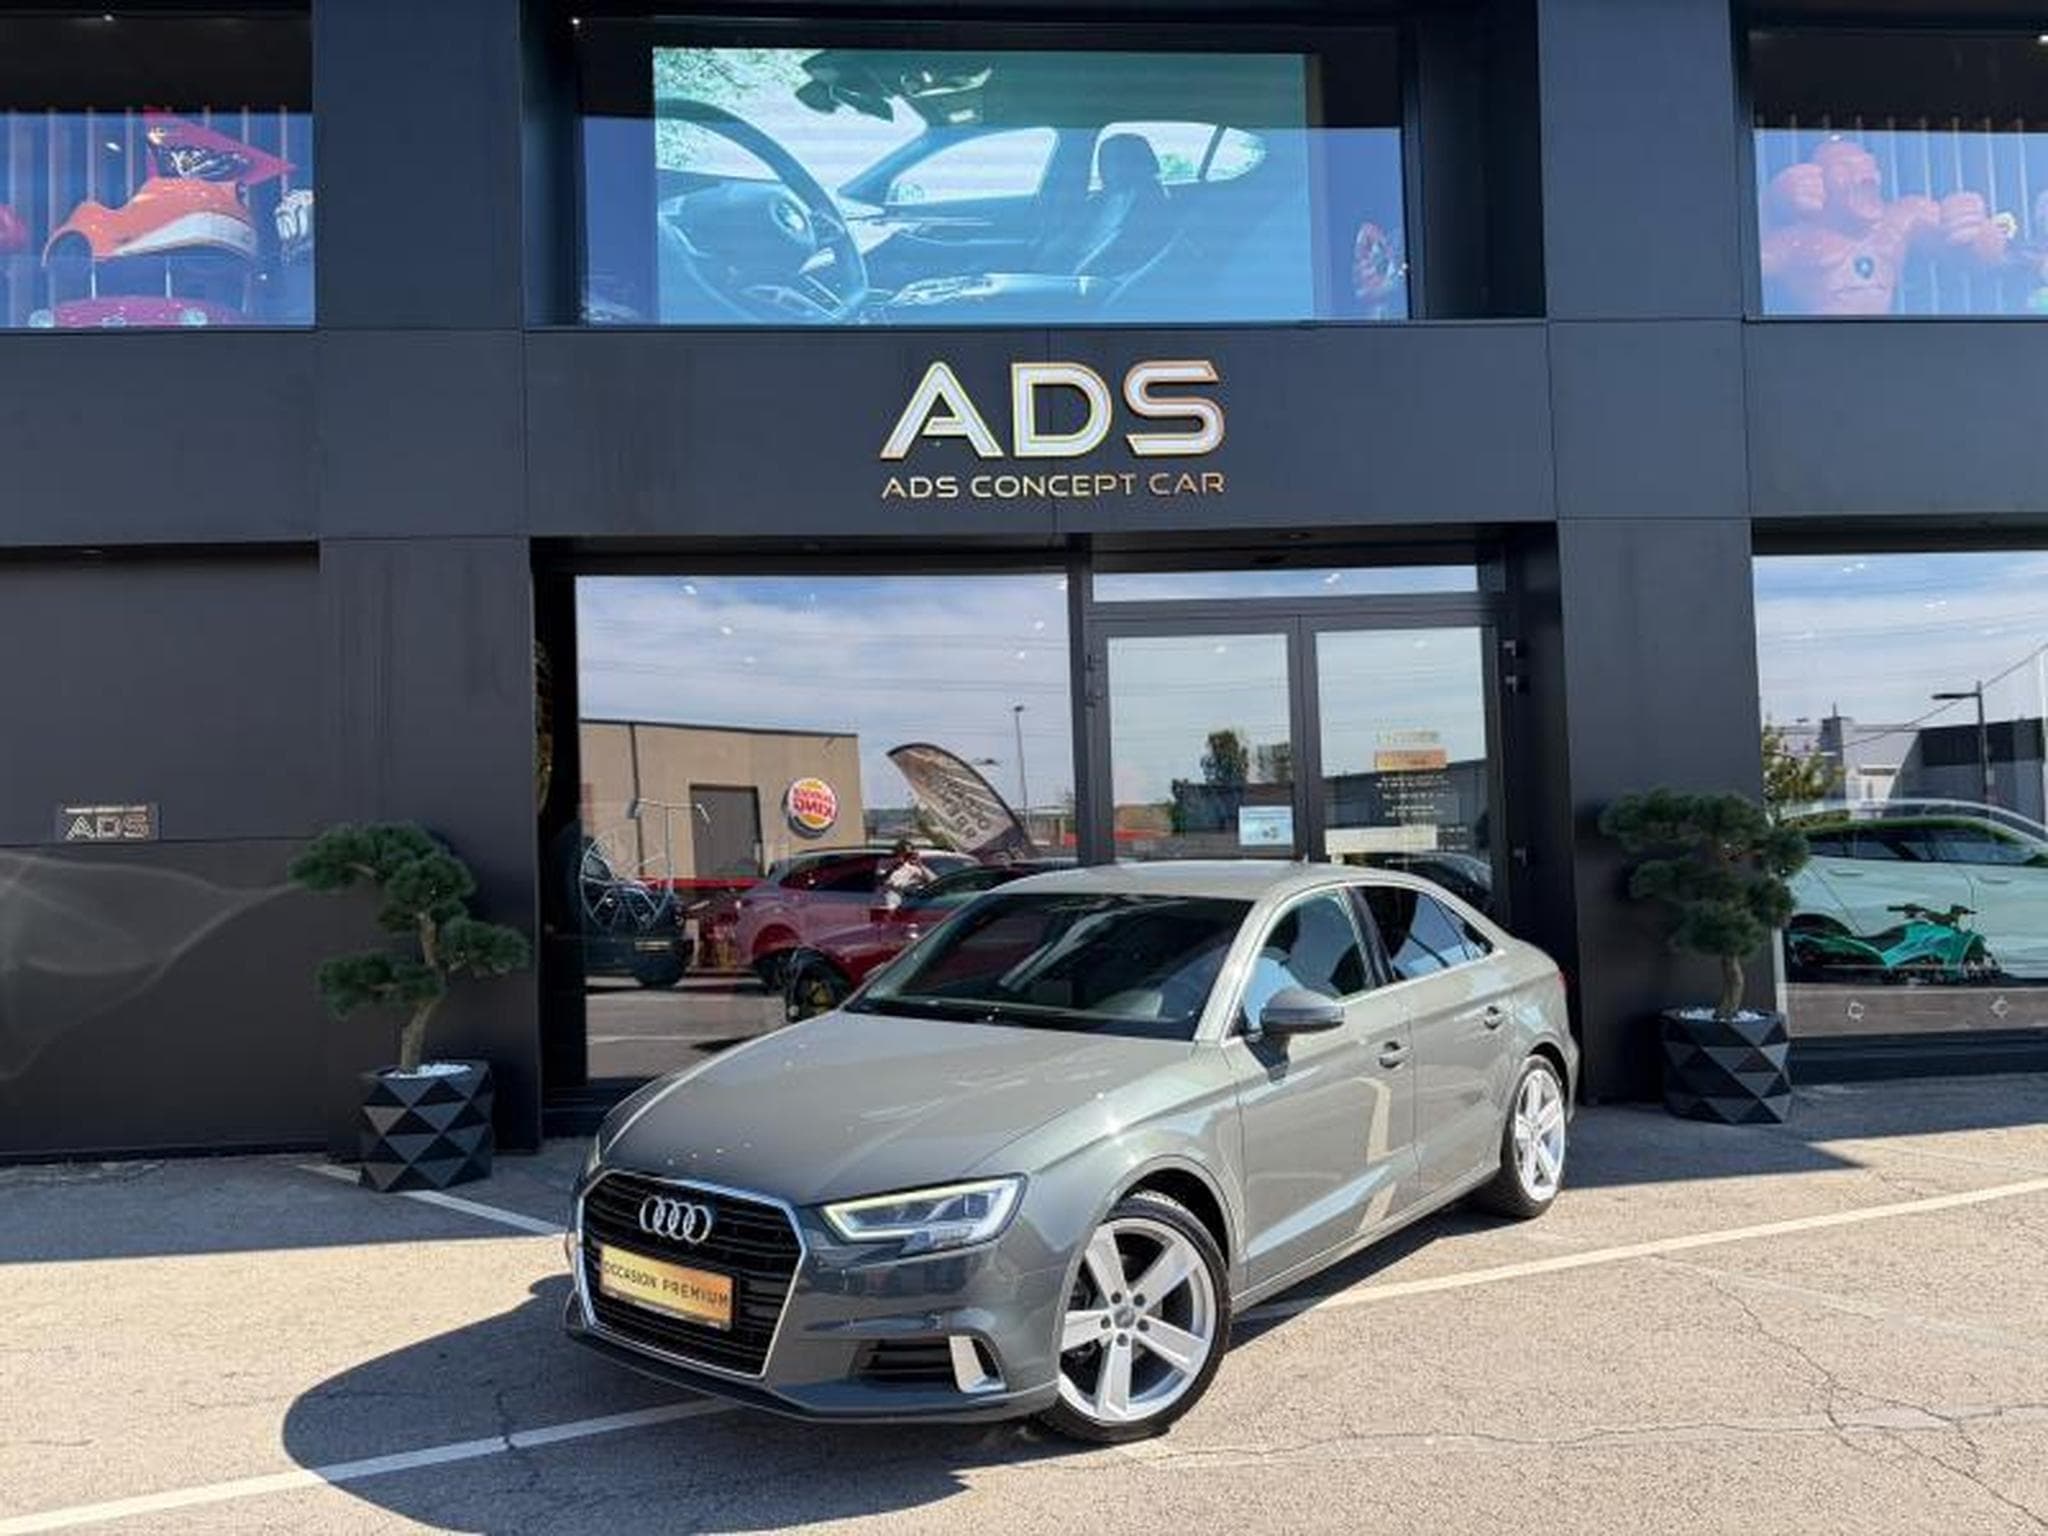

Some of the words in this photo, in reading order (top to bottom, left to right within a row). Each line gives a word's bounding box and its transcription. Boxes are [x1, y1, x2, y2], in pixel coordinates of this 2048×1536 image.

[880, 361, 1225, 459] ADS
[882, 476, 957, 499] ADS
[971, 473, 1136, 498] CONCEPT
[1149, 472, 1225, 494] CAR
[66, 815, 149, 840] ADS
[604, 1260, 657, 1289] OCCASION
[662, 1279, 728, 1307] PREMIUM
